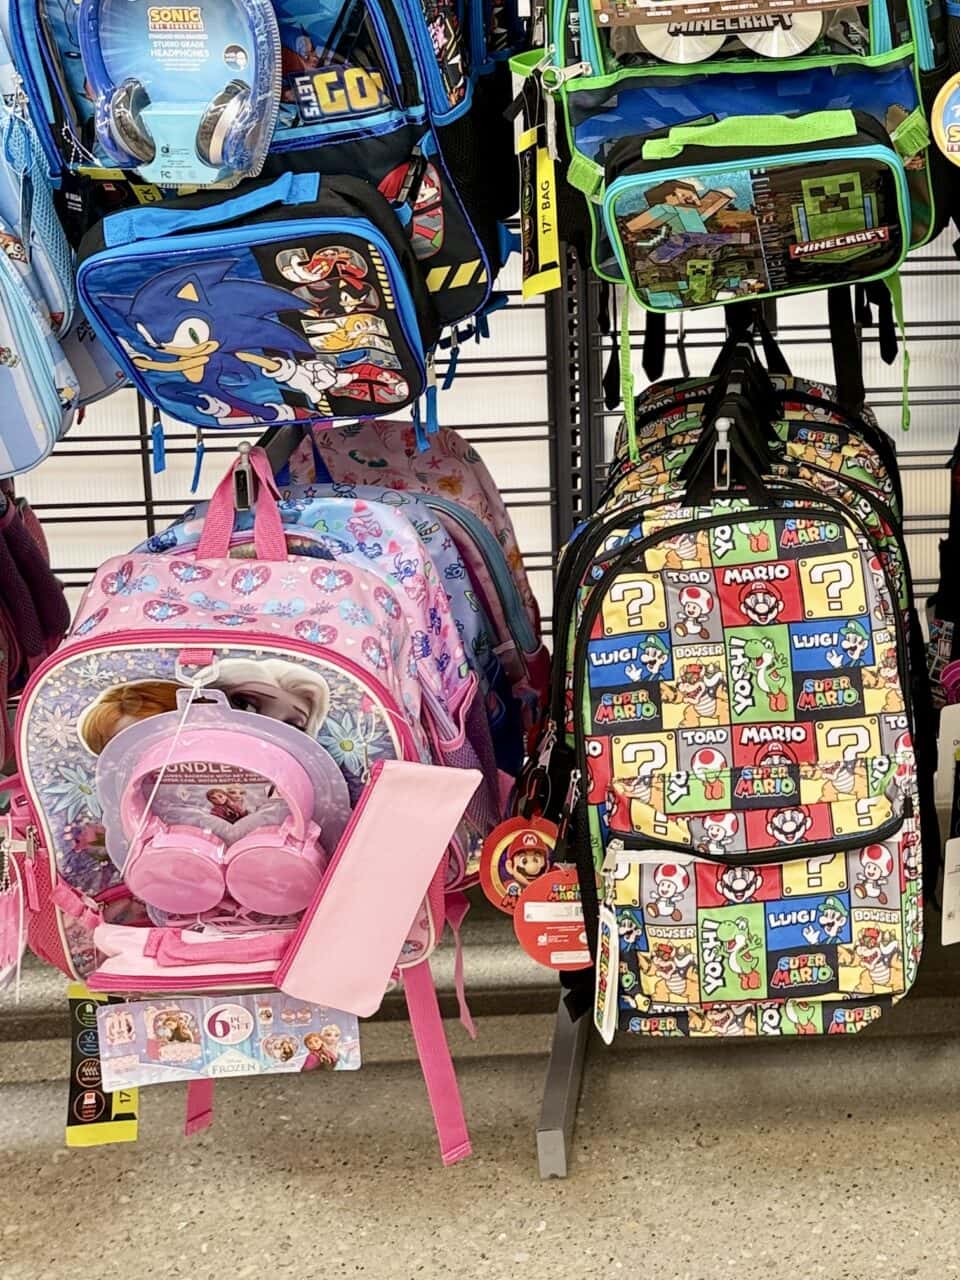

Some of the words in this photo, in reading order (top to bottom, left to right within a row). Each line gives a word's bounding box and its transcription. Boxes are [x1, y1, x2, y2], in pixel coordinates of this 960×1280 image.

[150, 8, 202, 23] SONIC
[668, 13, 793, 37] MINECRAFT
[295, 76, 320, 117] LET'S
[540, 180, 551, 210] BAG
[542, 214, 552, 235] 17"
[794, 229, 886, 255] MINECRAFT
[797, 427, 841, 443] SUPER
[779, 522, 842, 549] MARIO
[667, 570, 711, 585] TOAD
[723, 564, 790, 585] MARIO
[791, 630, 840, 649] LUIGI
[590, 647, 638, 667] LUIGI
[675, 644, 724, 658] BOWSER
[728, 636, 756, 717] YOSHI
[803, 675, 850, 693] SUPER
[602, 688, 649, 707] SUPER
[798, 687, 860, 711] MARIO
[593, 700, 658, 723] MARIO
[885, 716, 907, 730] TO
[682, 729, 728, 746] TOAD
[741, 725, 806, 745] MARIO
[164, 762, 232, 773] UNDLE
[734, 773, 798, 798] MARIO
[552, 883, 580, 892] SUPE
[768, 909, 817, 928] LUIGI
[854, 909, 899, 924] BOWSER
[647, 926, 695, 940] BOWSER
[701, 919, 727, 996] YOSHI
[777, 953, 826, 971] SUPER
[770, 964, 835, 990] MARIO
[207, 1008, 231, 1038] 6
[629, 1016, 677, 1032] SUPER
[833, 1005, 882, 1024] SUPER
[212, 1062, 257, 1075] FROZEN
